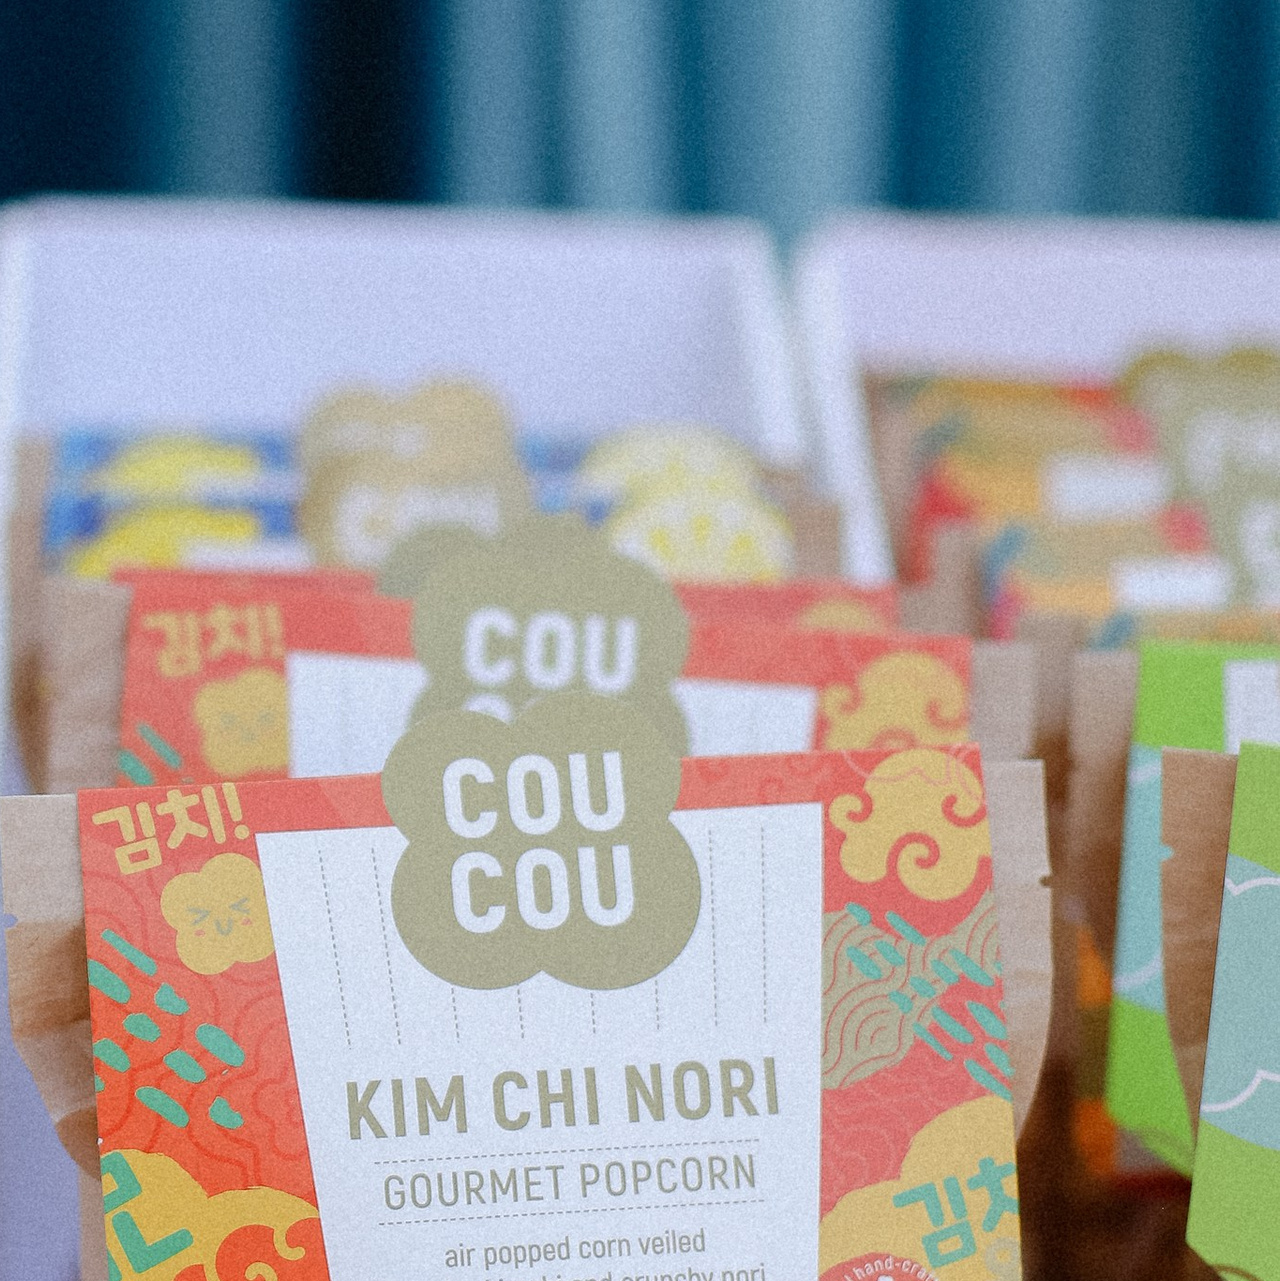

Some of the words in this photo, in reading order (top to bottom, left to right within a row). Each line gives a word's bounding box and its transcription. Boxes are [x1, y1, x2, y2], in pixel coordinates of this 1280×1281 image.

[463, 606, 638, 693] COU
[92, 782, 250, 876] 김치!
[443, 751, 625, 838] COU
[451, 844, 633, 934] COU
[345, 1075, 468, 1140] KIM
[492, 1066, 600, 1131] CHI
[625, 1056, 779, 1123] NORI
[384, 1165, 564, 1210] GOURMET
[580, 1154, 756, 1198] POPCORN
[445, 1243, 476, 1268] air
[483, 1236, 571, 1271] popped
[578, 1239, 631, 1260] corn
[638, 1228, 706, 1256] veiled
